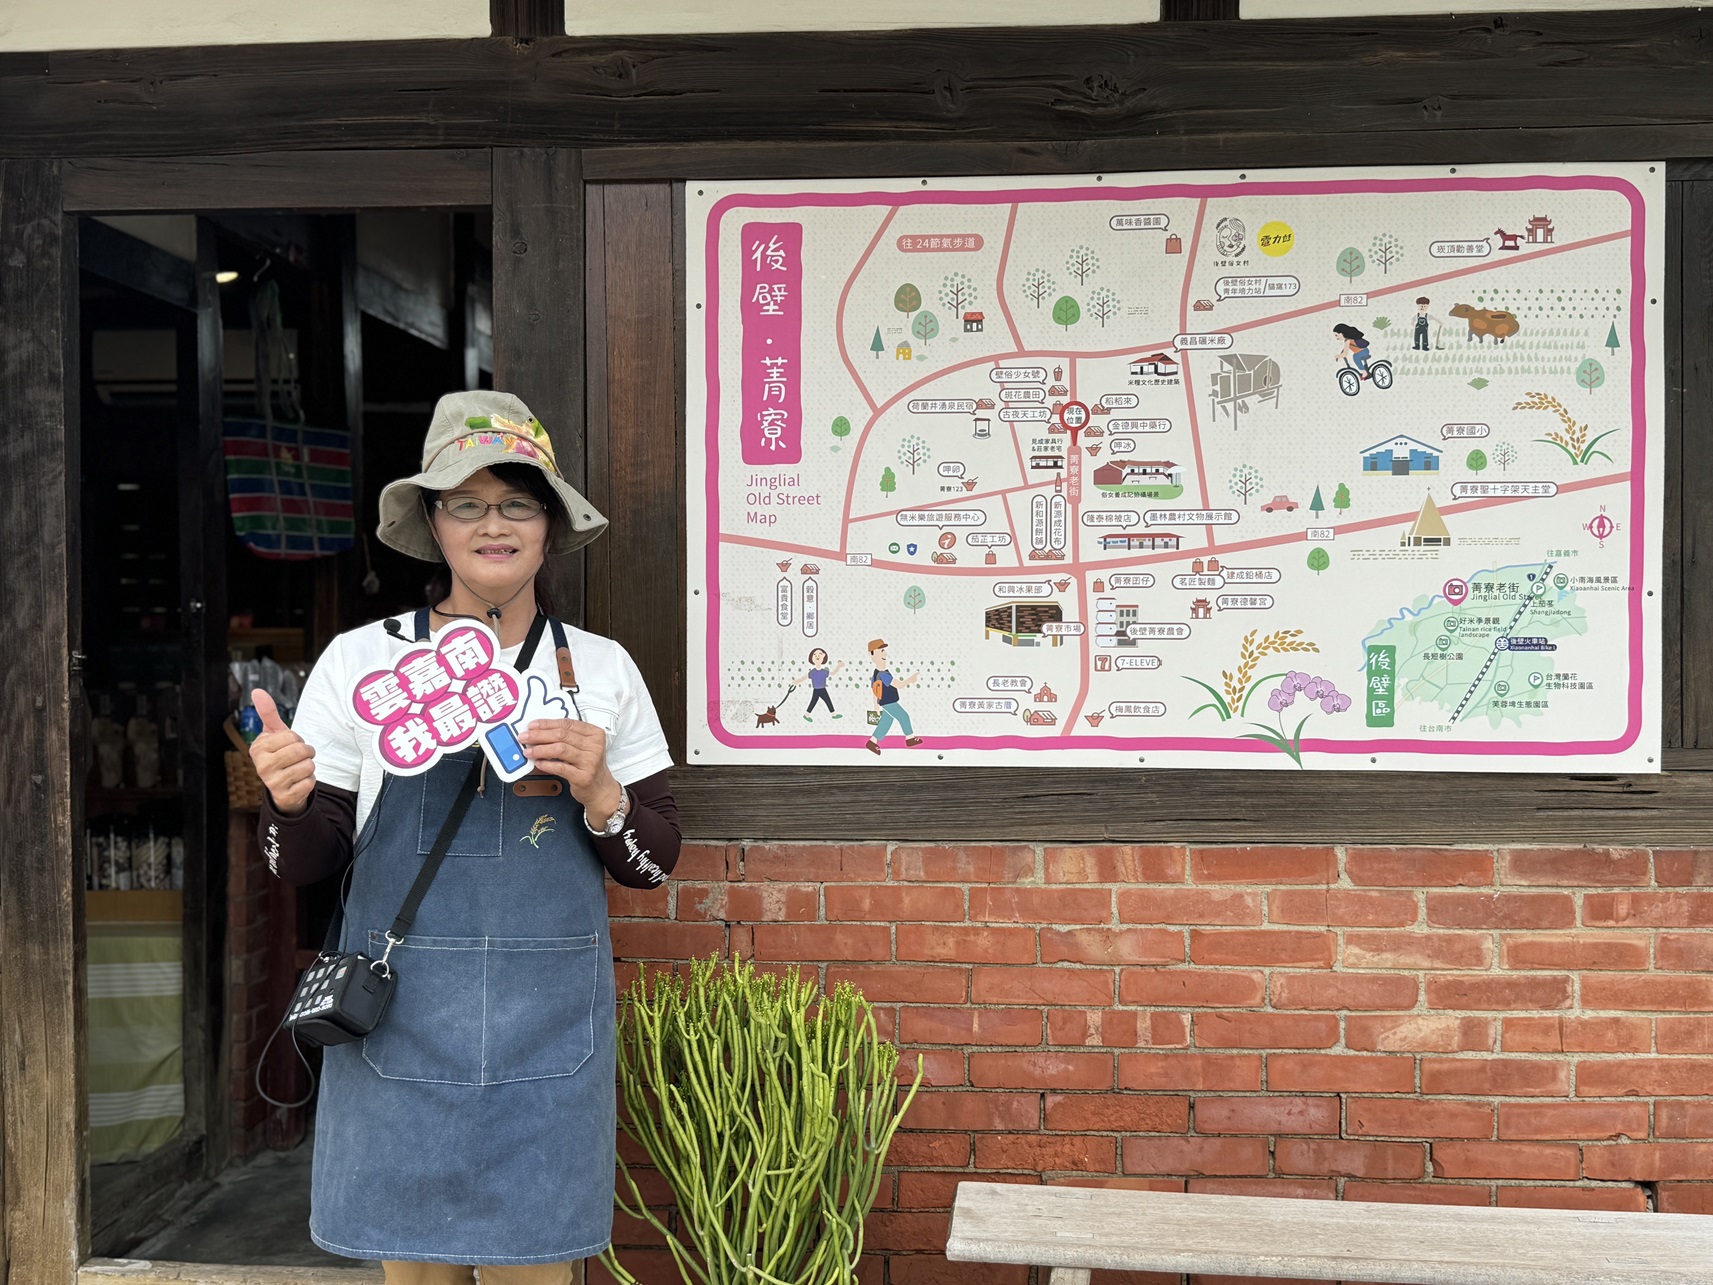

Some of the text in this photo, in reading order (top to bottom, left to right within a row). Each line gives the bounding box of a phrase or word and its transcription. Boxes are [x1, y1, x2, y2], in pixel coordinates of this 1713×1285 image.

[902, 237, 975, 249] 往 24節氣步道
[1223, 278, 1262, 287] 後壁俗女村
[1223, 287, 1262, 295] 青年培力站
[1343, 295, 1364, 305] 南82
[1180, 336, 1226, 346] 義昌碾米廠
[995, 369, 1041, 379] 壁俗少女號
[1067, 407, 1082, 415] 現在
[1445, 426, 1487, 436] 菁寮國小
[456, 435, 514, 451] TAIWAN
[1069, 454, 1079, 497] 菁寮老街
[1459, 484, 1551, 495] 菁寮聖十字架天主堂
[746, 493, 822, 506] Old Street
[746, 511, 777, 527] Map
[1616, 523, 1622, 531] E
[1310, 530, 1330, 538] 南82
[1598, 540, 1605, 549] S
[849, 556, 868, 564] 南82
[1570, 576, 1618, 584] 小南海風景區
[1471, 582, 1520, 593] 菁寮老街
[360, 630, 489, 721] 雲嘉南
[992, 679, 1028, 688] 長老教會
[1369, 649, 1392, 717] 後壁區
[1545, 682, 1594, 690] 生物科技園區
[387, 673, 518, 762] 我最讚
[1419, 724, 1452, 733] 往台南市
[622, 828, 641, 862] happy
[635, 850, 663, 881] healthy
